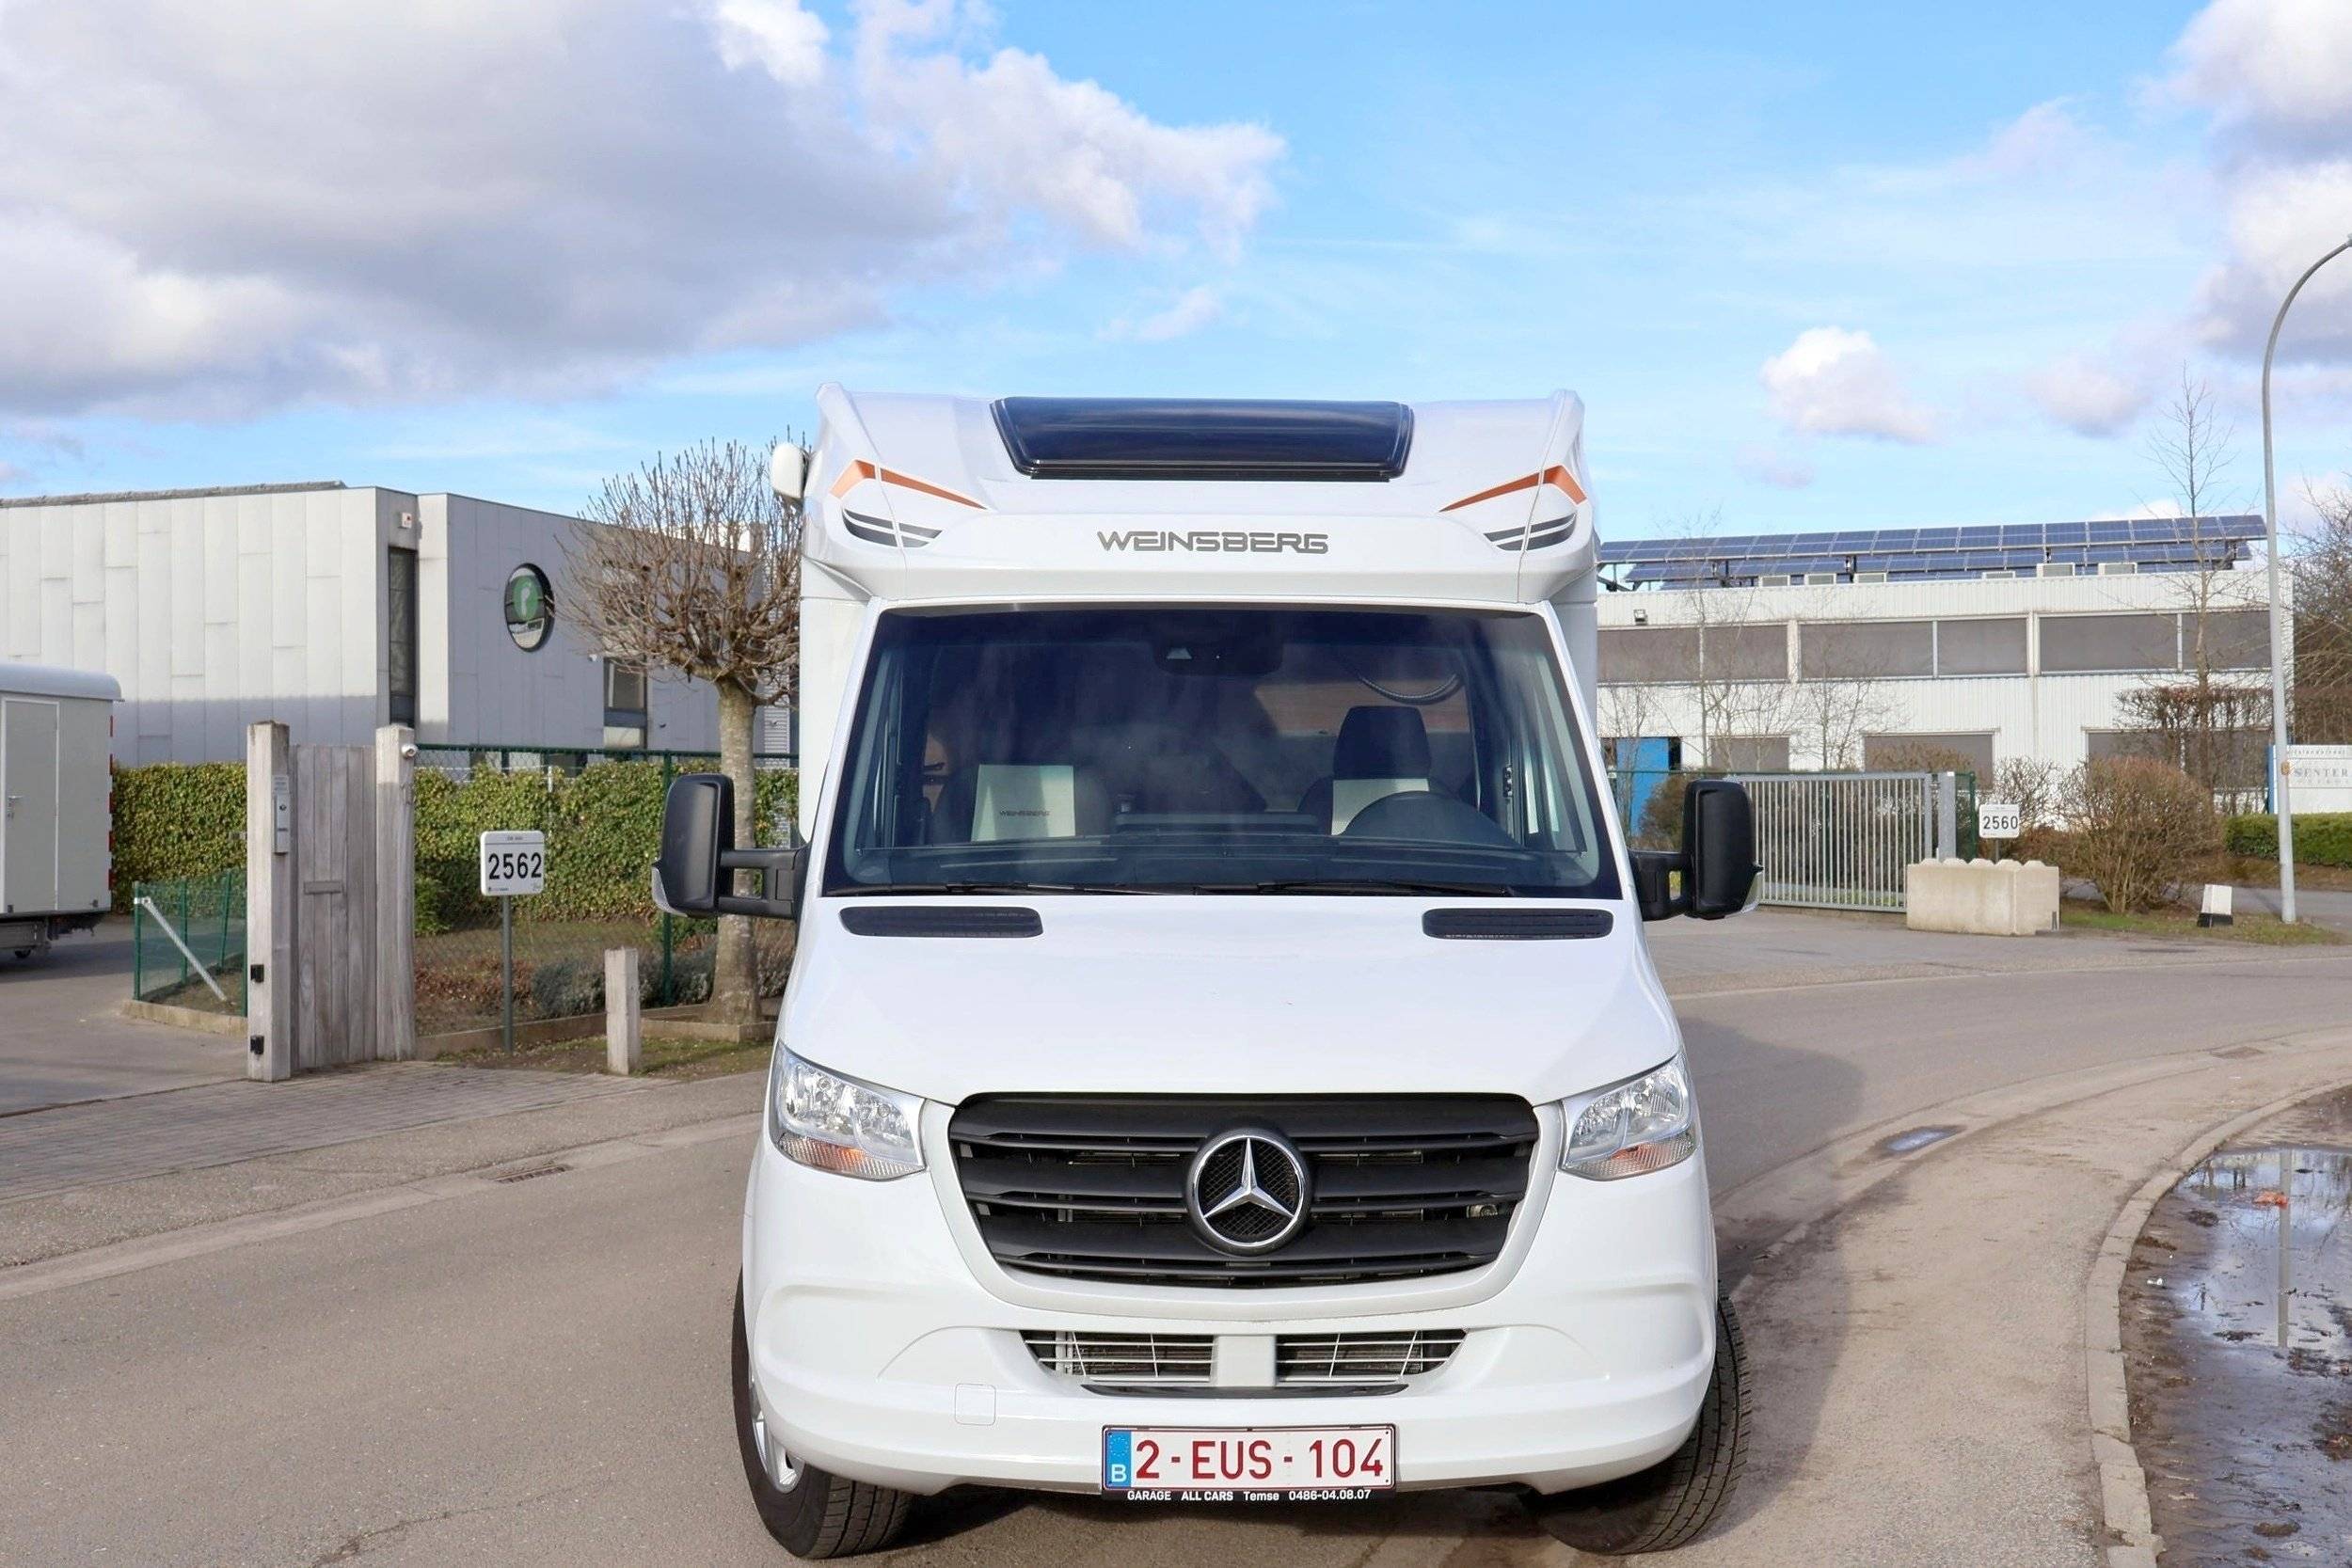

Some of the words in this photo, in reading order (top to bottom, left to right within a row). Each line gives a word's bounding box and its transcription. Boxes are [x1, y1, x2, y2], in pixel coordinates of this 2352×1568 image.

[1097, 531, 1328, 554] WEINSBERG
[1982, 815, 2019, 830] 2560
[488, 851, 542, 879] 2562
[1111, 1464, 1127, 1482] B
[1127, 1490, 1171, 1500] GARAGE
[1181, 1490, 1202, 1501] ALL
[1204, 1491, 1233, 1501] CARS
[1243, 1491, 1280, 1501] Temse
[1288, 1489, 1372, 1500] 0486-04.08.07
